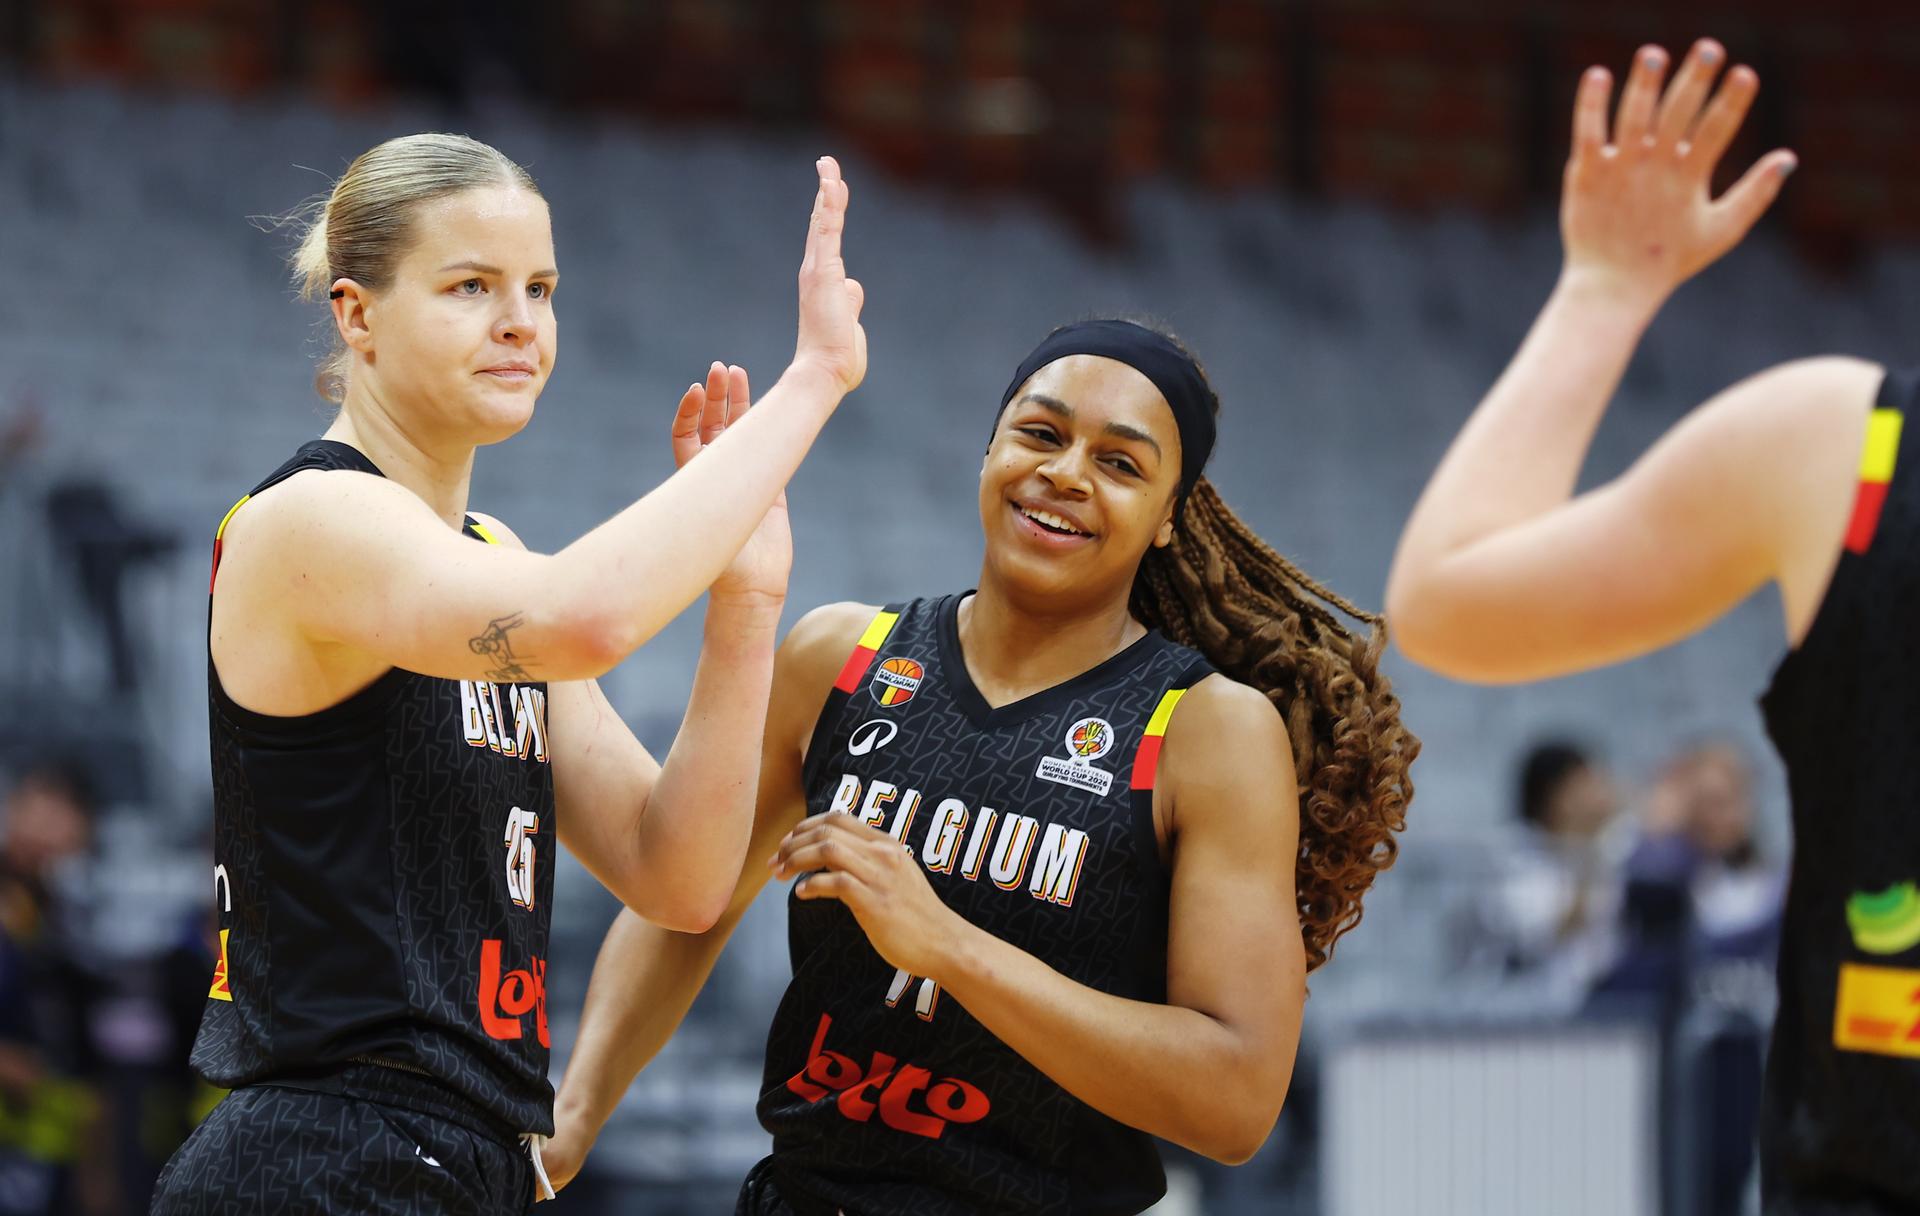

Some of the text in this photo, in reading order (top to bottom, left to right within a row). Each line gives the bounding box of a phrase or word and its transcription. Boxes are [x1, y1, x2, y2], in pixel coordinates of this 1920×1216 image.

[1042, 764, 1108, 787] WORLD CUP 2026
[504, 806, 540, 913] 25
[829, 774, 1090, 907] BELGIUM
